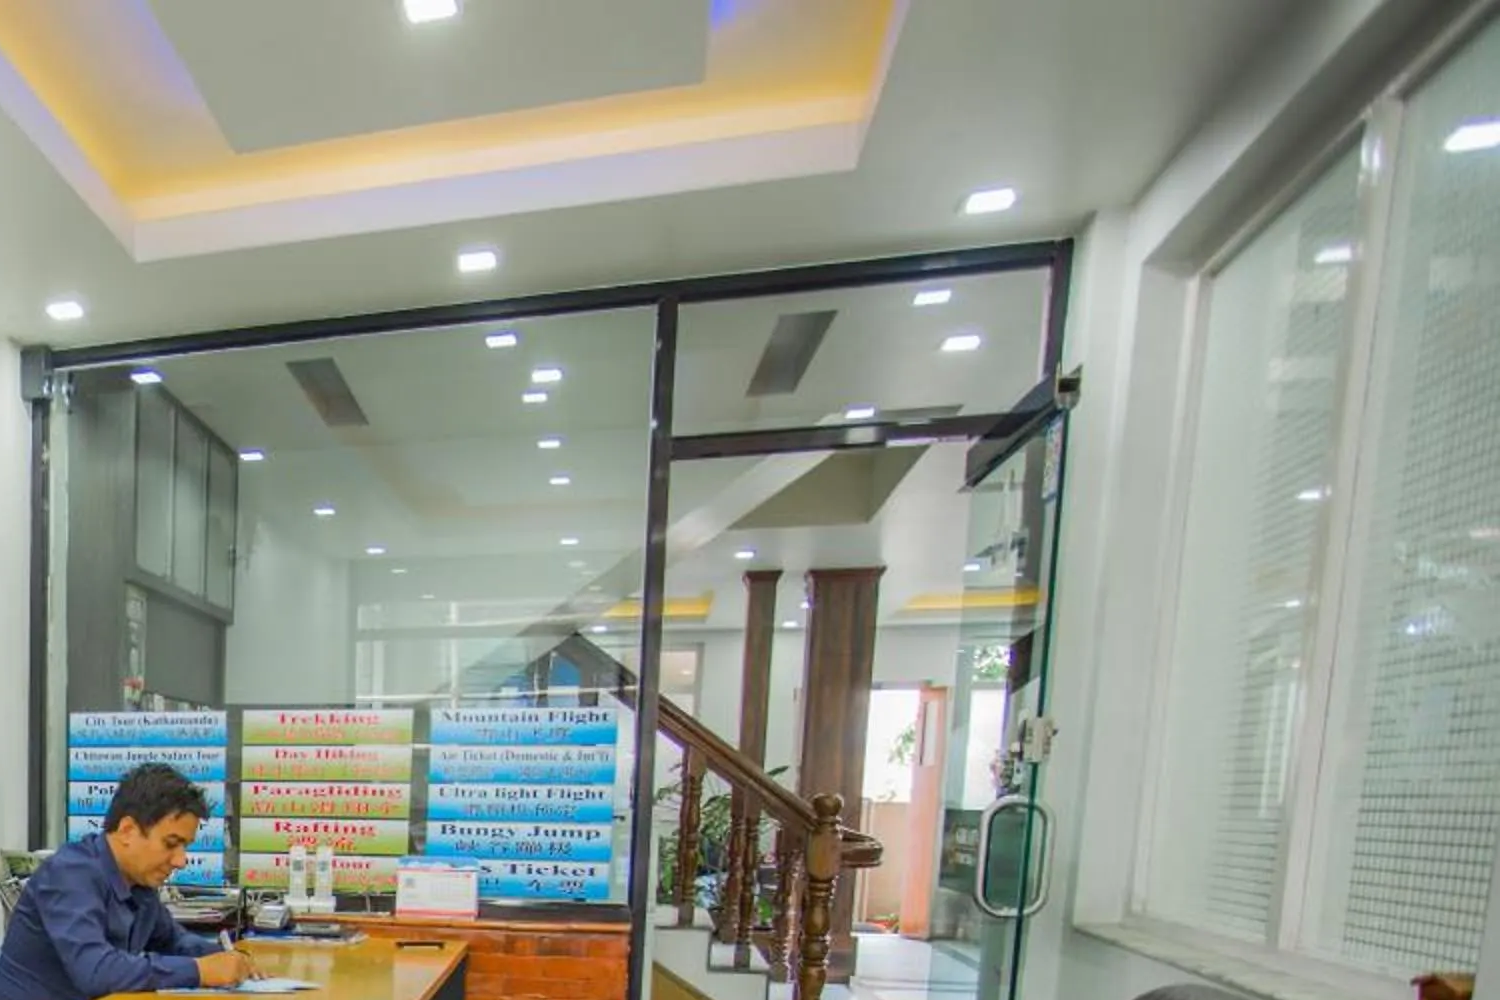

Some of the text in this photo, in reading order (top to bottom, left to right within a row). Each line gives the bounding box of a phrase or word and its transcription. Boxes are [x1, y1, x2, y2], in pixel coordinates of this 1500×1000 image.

[276, 713, 381, 726] Trekking
[442, 711, 609, 725] Mountain Flight
[314, 749, 380, 762] Hiking
[252, 785, 403, 799] Paragliding
[438, 788, 606, 801] Ultra light Flight
[274, 821, 376, 837] Rafting
[441, 824, 601, 841] Bungy Jump
[503, 863, 595, 877] Ticket
